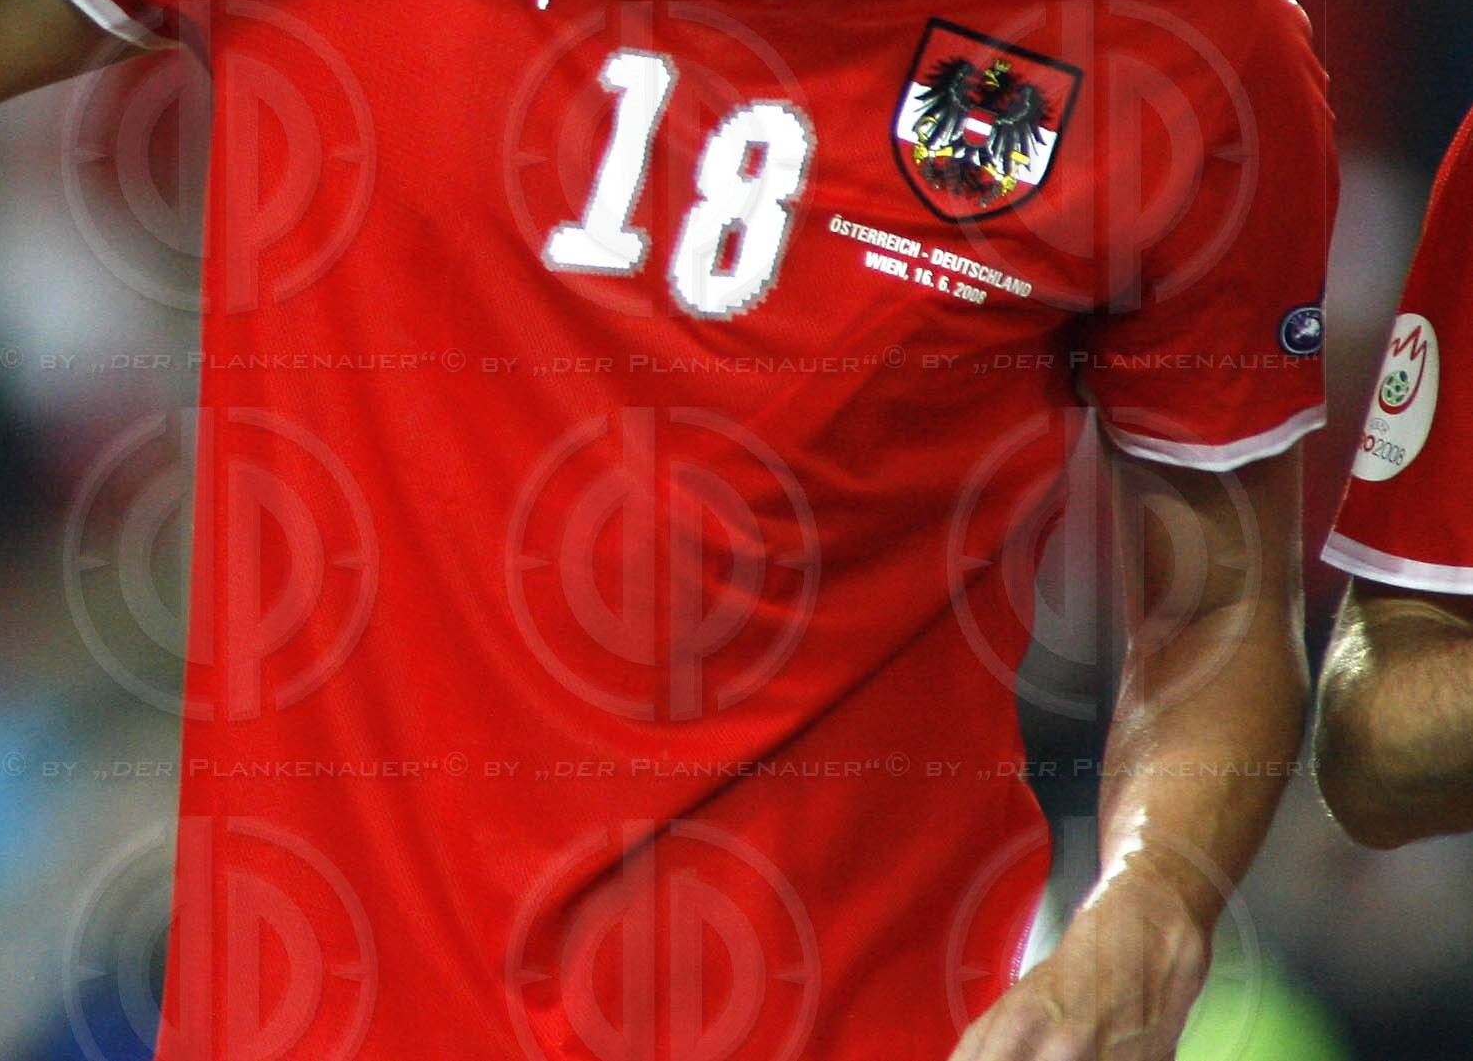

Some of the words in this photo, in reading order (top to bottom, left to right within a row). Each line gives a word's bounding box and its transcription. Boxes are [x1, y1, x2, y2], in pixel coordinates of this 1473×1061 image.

[543, 48, 817, 320] 18
[830, 214, 921, 258] ÖSTERREICH
[931, 248, 1032, 297] DEUTSCHLAND
[865, 251, 909, 280] WIEN,
[953, 281, 988, 305] 2008
